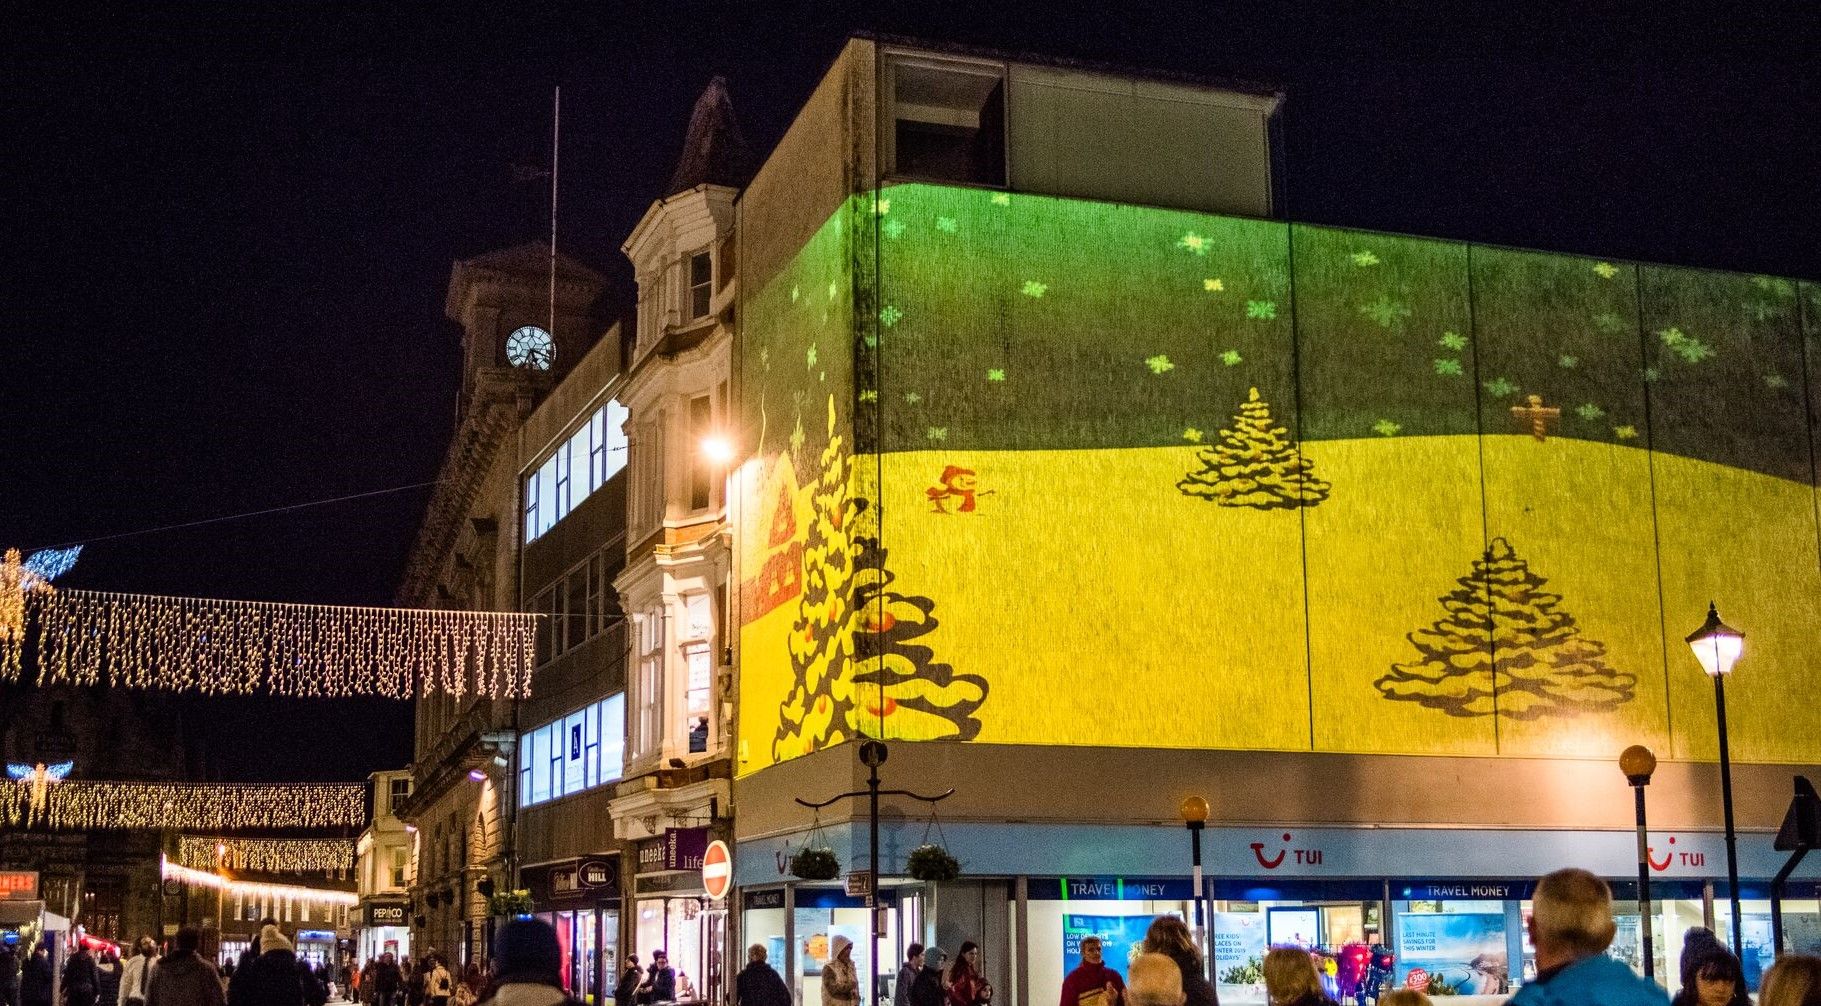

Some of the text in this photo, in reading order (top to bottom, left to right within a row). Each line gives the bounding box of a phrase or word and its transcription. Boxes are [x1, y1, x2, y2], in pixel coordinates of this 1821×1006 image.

[683, 855, 704, 869] life
[1294, 849, 1323, 865] TUI
[1679, 852, 1705, 867] TUI
[588, 872, 607, 882] HILL
[1070, 883, 1166, 896] TRAVEL ONEY
[1427, 885, 1510, 896] TRAVEL MONEY
